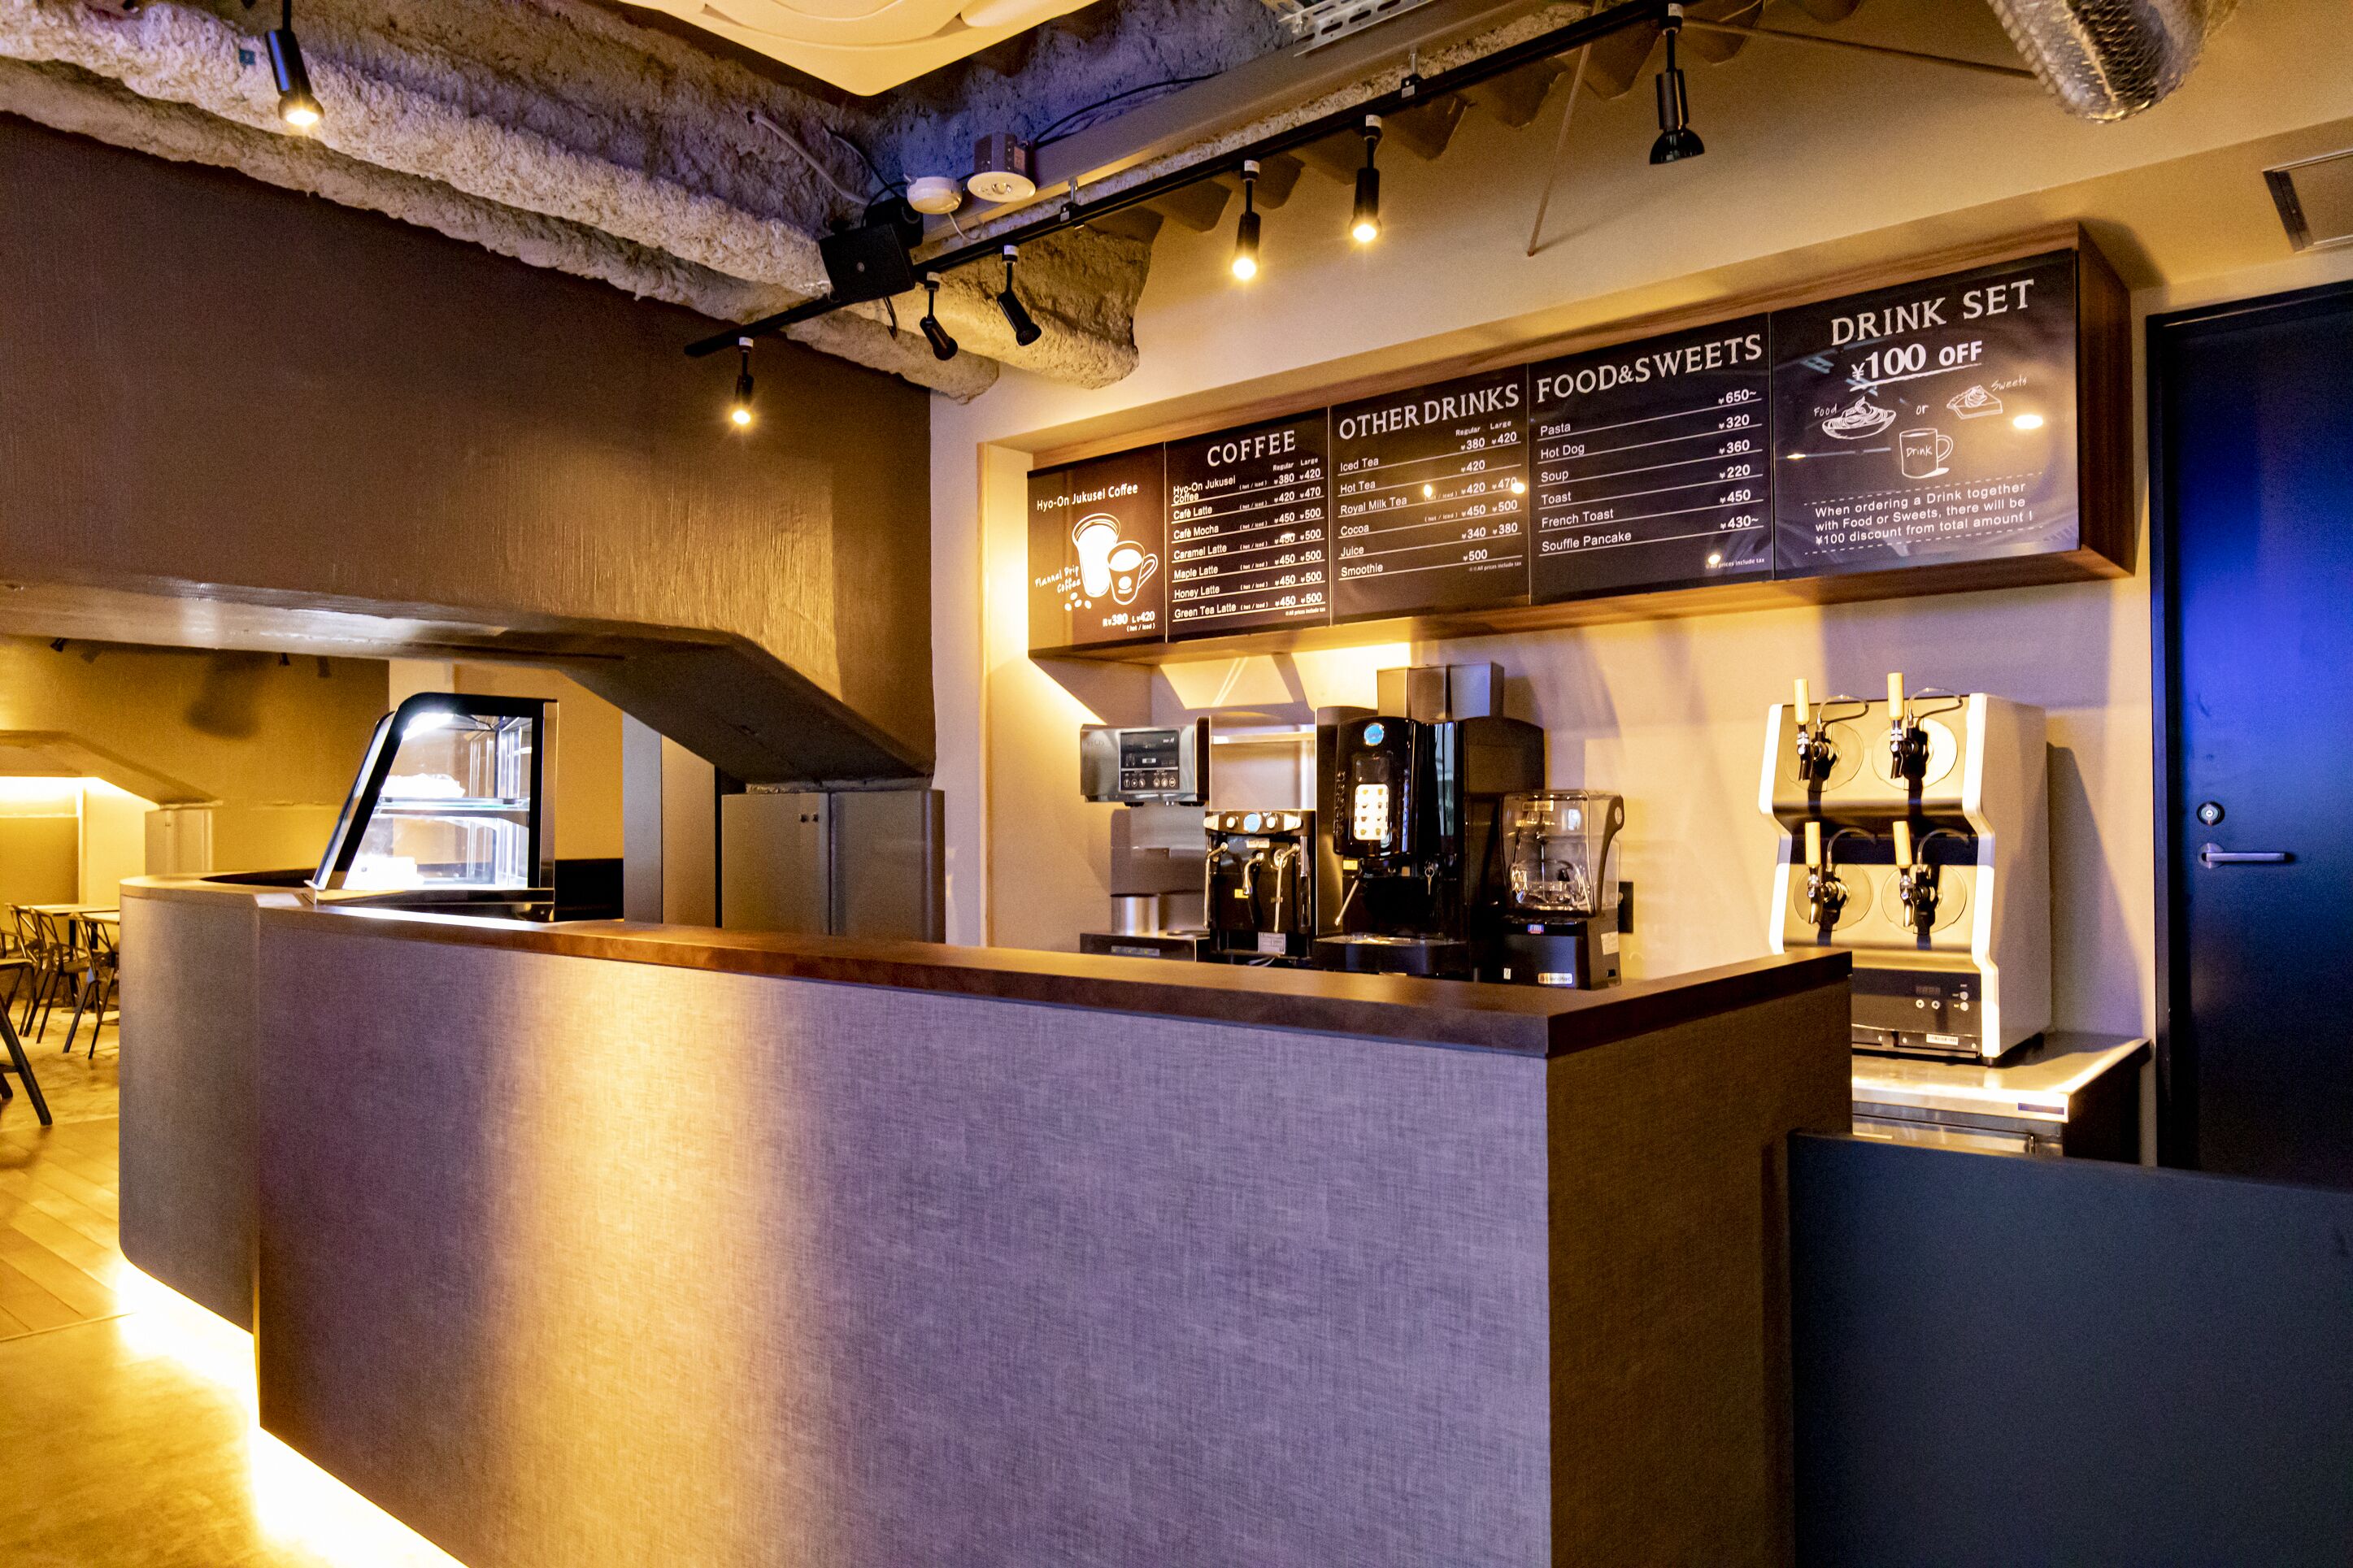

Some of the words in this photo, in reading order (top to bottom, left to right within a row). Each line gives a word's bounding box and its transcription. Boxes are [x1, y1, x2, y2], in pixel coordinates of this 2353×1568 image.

[1831, 298, 1946, 346] DRINK
[1963, 279, 2034, 319] SET
[1537, 333, 1763, 403] FOOD&SWEETS
[1851, 343, 1926, 380] ¥100
[1939, 341, 1982, 364] OFF
[1991, 374, 2027, 392] Sweets
[1339, 405, 1420, 440] OTHER
[1424, 384, 1519, 424] DRINKS
[1814, 403, 1838, 416] Food
[1916, 404, 1929, 415] or
[1455, 426, 1481, 437] Regular
[1490, 421, 1511, 431] Large
[1541, 423, 1571, 436] Pasta
[1541, 447, 1559, 459] Hot
[1563, 444, 1585, 456] Dog
[1719, 414, 1750, 430] ¥320
[1207, 430, 1295, 467] COFFEE
[1340, 460, 1359, 471] Iced
[1362, 457, 1379, 468] Tea
[1460, 438, 1485, 450] ¥380
[1491, 432, 1517, 445] ¥420
[1542, 471, 1568, 484] Soup
[1719, 440, 1750, 455] ¥360
[1906, 445, 1932, 458] Drink
[1273, 463, 1294, 471] Regular
[1301, 458, 1319, 467] Large
[1340, 482, 1356, 494] Hot
[1359, 481, 1376, 491] Tea
[1460, 460, 1485, 472] ¥420
[1173, 482, 1203, 496] Hyo-On
[1205, 475, 1236, 490] Jukusei
[1274, 473, 1294, 484] ¥380
[1300, 468, 1320, 480] ¥420
[1542, 492, 1571, 504] Toast
[1720, 464, 1750, 479] ¥220
[1037, 496, 1069, 512] Hyo-On
[1072, 488, 1105, 505] Jukusei
[1108, 483, 1138, 497] Coffee
[1173, 493, 1198, 504] Coffee
[1194, 506, 1212, 517] Latte
[1274, 492, 1294, 503] ¥420
[1300, 487, 1320, 498] ¥470
[1340, 502, 1366, 515] Royal
[1368, 499, 1386, 510] Milk
[1390, 496, 1407, 506] Tea
[1461, 482, 1485, 494] ¥420
[1542, 515, 1578, 528] French
[1583, 509, 1613, 522] Toast
[1720, 489, 1751, 504] ¥450
[1816, 505, 1850, 518] When
[1855, 498, 1907, 514] ordering
[1927, 491, 1961, 504] Drink
[1968, 483, 2025, 499] together
[1194, 525, 1219, 537] Mocha
[1274, 512, 1294, 523] ¥450
[1300, 508, 1321, 519] ¥500
[1340, 523, 1369, 536] Cocoa
[1462, 505, 1485, 517] ¥450
[1493, 500, 1517, 512] ¥500
[1816, 520, 1838, 532] with
[1843, 516, 1872, 528] Food
[1877, 516, 1889, 524] or
[1894, 510, 1941, 523] Sweets,
[1946, 504, 1978, 516] there
[1984, 500, 2003, 511] will
[2010, 497, 2025, 507] be
[1174, 546, 1205, 559] Caramel
[1208, 545, 1227, 554] Latte
[1300, 528, 1321, 541] ¥500
[1341, 546, 1364, 557] Juice
[1462, 528, 1486, 539] ¥340
[1493, 522, 1518, 535] ¥380
[1542, 538, 1579, 552] Souffle
[1584, 532, 1631, 546] Pancake
[1816, 533, 1845, 546] ¥100
[1850, 528, 1901, 541] discount
[1907, 523, 1934, 535] from
[1940, 519, 1968, 531] total
[1973, 514, 2024, 526] amount
[1035, 570, 1062, 588] Flannel
[1064, 564, 1079, 577] Drip
[1174, 568, 1197, 580] Maple
[1199, 566, 1218, 576] Latte
[1275, 554, 1295, 566] ¥450
[1301, 550, 1321, 562] ¥500
[1342, 563, 1383, 577] Smoothie
[1464, 549, 1487, 562] ¥500
[1057, 578, 1081, 593] Coffee
[1174, 588, 1198, 599] Honey
[1201, 585, 1220, 595] Latte
[1275, 575, 1295, 586] ¥450
[1301, 571, 1321, 583] ¥500
[1175, 608, 1198, 619] Green
[1200, 606, 1214, 615] Tea
[1216, 602, 1236, 613] Latte
[1275, 596, 1296, 607] ¥450
[1301, 593, 1322, 604] ¥500
